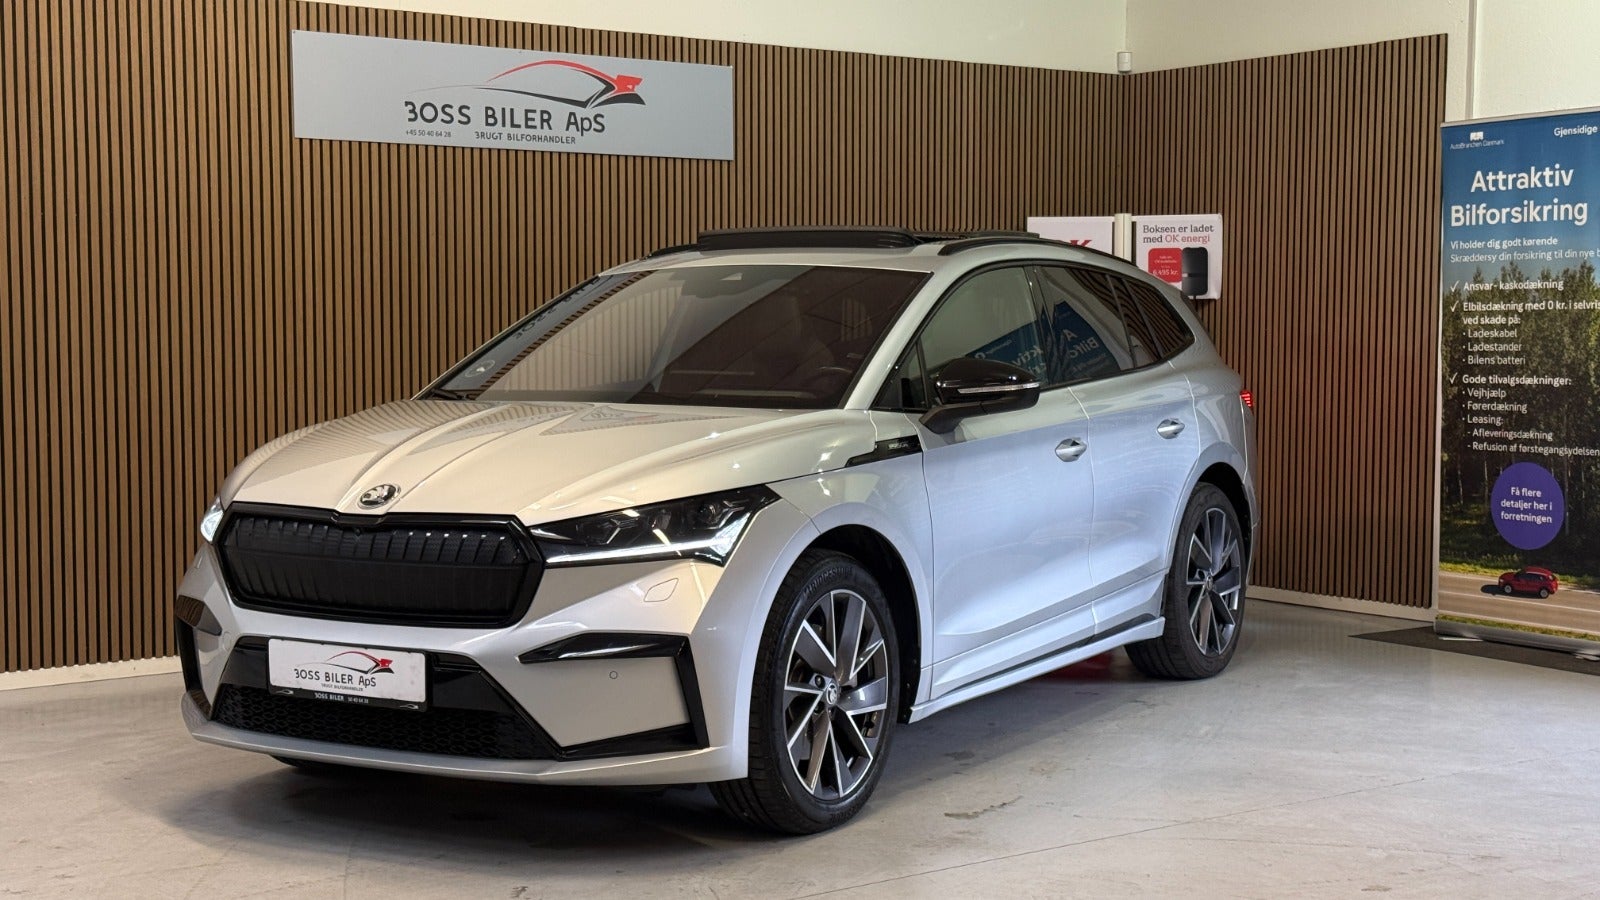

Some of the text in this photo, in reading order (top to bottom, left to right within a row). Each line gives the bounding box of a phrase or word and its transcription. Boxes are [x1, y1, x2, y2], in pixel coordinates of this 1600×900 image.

[484, 106, 553, 131] BILER
[565, 111, 606, 136] ApS
[1553, 125, 1599, 137] Gjensidige
[507, 133, 576, 144] BILFORHANDLER
[1470, 163, 1574, 193] Attraktiv
[1451, 198, 1588, 227] Bilforsikring
[1143, 223, 1214, 234] Boksen er ladet
[1143, 234, 1210, 245] med OK energi
[1450, 236, 1558, 250] Vi holder dig godt kørende
[1450, 253, 1497, 263] Skræddersy
[1499, 252, 1512, 262] din
[1513, 251, 1552, 263] forsikring
[1554, 249, 1563, 259] til
[1564, 248, 1578, 258] din
[1579, 249, 1595, 260] nye
[1463, 279, 1564, 291] Ansvar- kaskodækning
[1463, 301, 1523, 313] Elbilsdækning
[1525, 301, 1545, 311] med
[1555, 300, 1568, 310] kr.
[1463, 314, 1521, 326] ved skade på:
[1468, 329, 1518, 338] Ladeskabel
[1468, 342, 1522, 352] Ladestander
[1468, 356, 1526, 365] Bilens batteri
[1462, 374, 1572, 387] Gode tilvalgsdækninger:
[1467, 388, 1507, 399] Vejhjælp
[1467, 403, 1528, 414] Førerdækning
[1467, 414, 1504, 425] Leasing:
[1472, 428, 1553, 441] Afleveringsdækning
[1472, 441, 1508, 451] Refusion
[1509, 442, 1517, 452] af
[1510, 486, 1542, 497] Få flere
[1500, 499, 1532, 511] detaljer
[1533, 501, 1548, 510] her
[1500, 511, 1553, 524] forretningen
[325, 672, 353, 685] BILER
[358, 675, 376, 689] ApS
